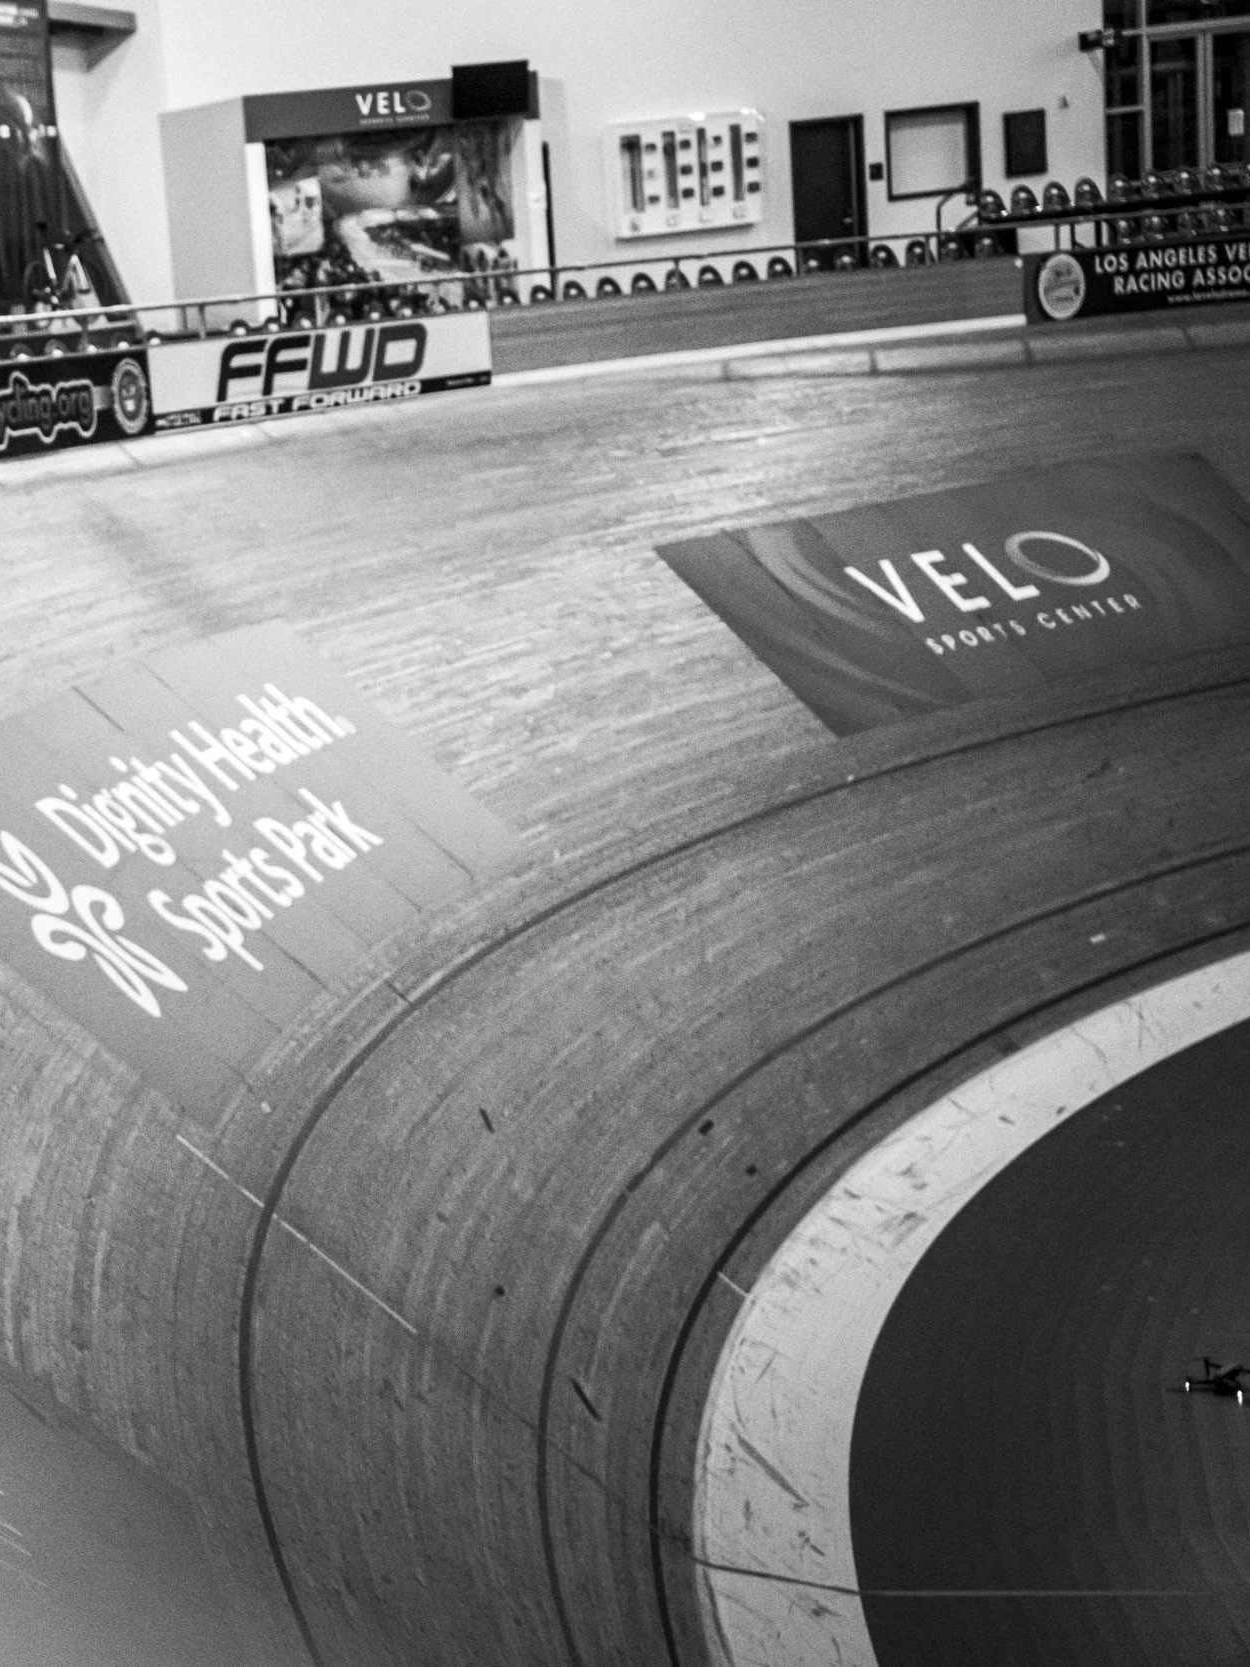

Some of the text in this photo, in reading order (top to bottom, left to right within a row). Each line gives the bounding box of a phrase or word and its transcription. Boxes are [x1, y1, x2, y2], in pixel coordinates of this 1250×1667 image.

[354, 90, 432, 116] VELO
[1094, 242, 1250, 274] LOS ANGELES VE
[1114, 269, 1185, 295] RACING
[216, 323, 427, 402] FFWD
[213, 398, 285, 422] FAST
[291, 380, 422, 413] FORWARD
[843, 530, 1111, 623] VELO
[925, 593, 1143, 656] SPORTS CENTER
[34, 753, 233, 869] Dignity
[147, 786, 385, 972] Sports Park
